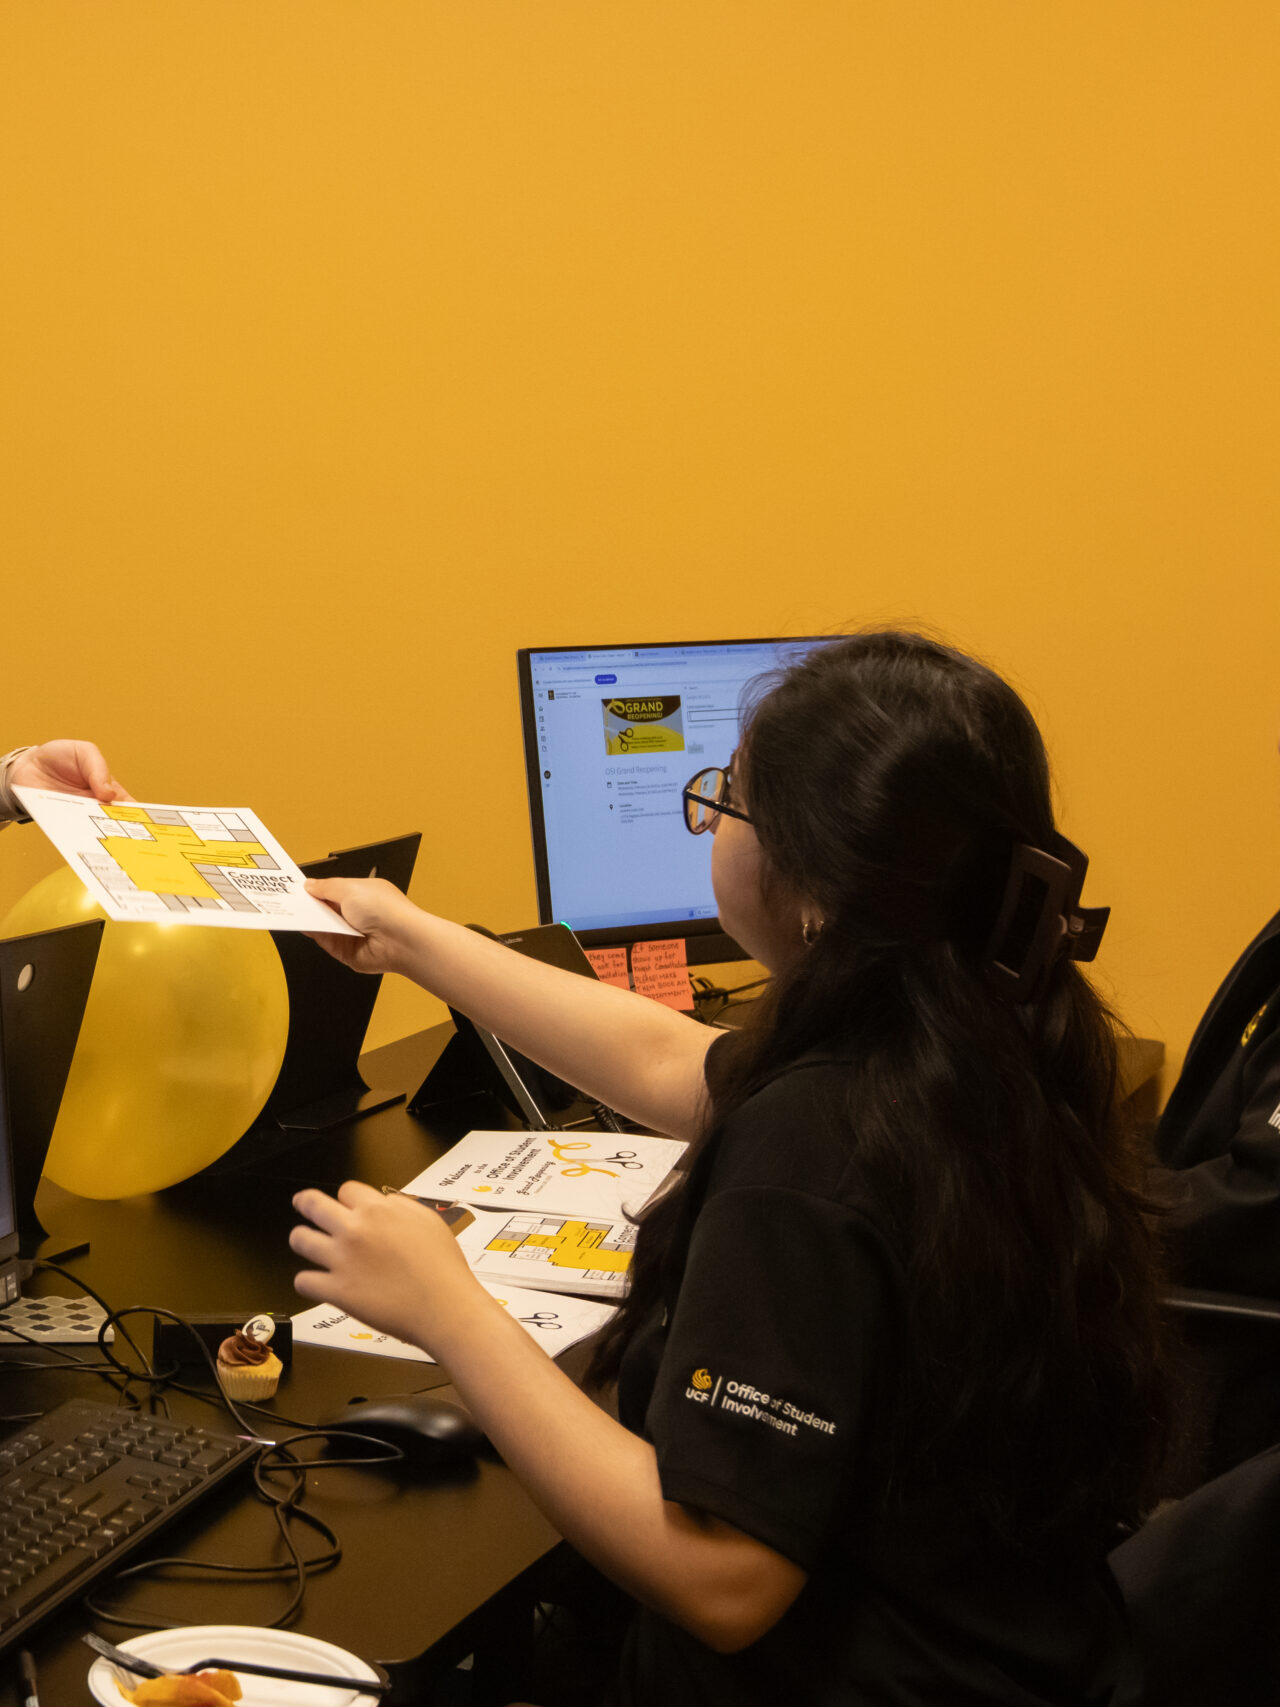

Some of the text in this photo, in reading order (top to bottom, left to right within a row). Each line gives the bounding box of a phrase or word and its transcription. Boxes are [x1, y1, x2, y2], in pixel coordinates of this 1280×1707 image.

[625, 701, 664, 713] GRAND
[227, 871, 295, 883] Connect
[231, 878, 287, 888] Involve
[234, 882, 291, 894] Impact
[486, 1162, 511, 1179] Office
[509, 1137, 537, 1156] Student
[502, 1148, 542, 1180] Involvement
[438, 1163, 472, 1186] Welcome
[312, 1313, 349, 1330] Welco
[685, 1387, 710, 1403] UCF
[721, 1395, 799, 1436] Involvement
[726, 1381, 837, 1435] Office of Student
